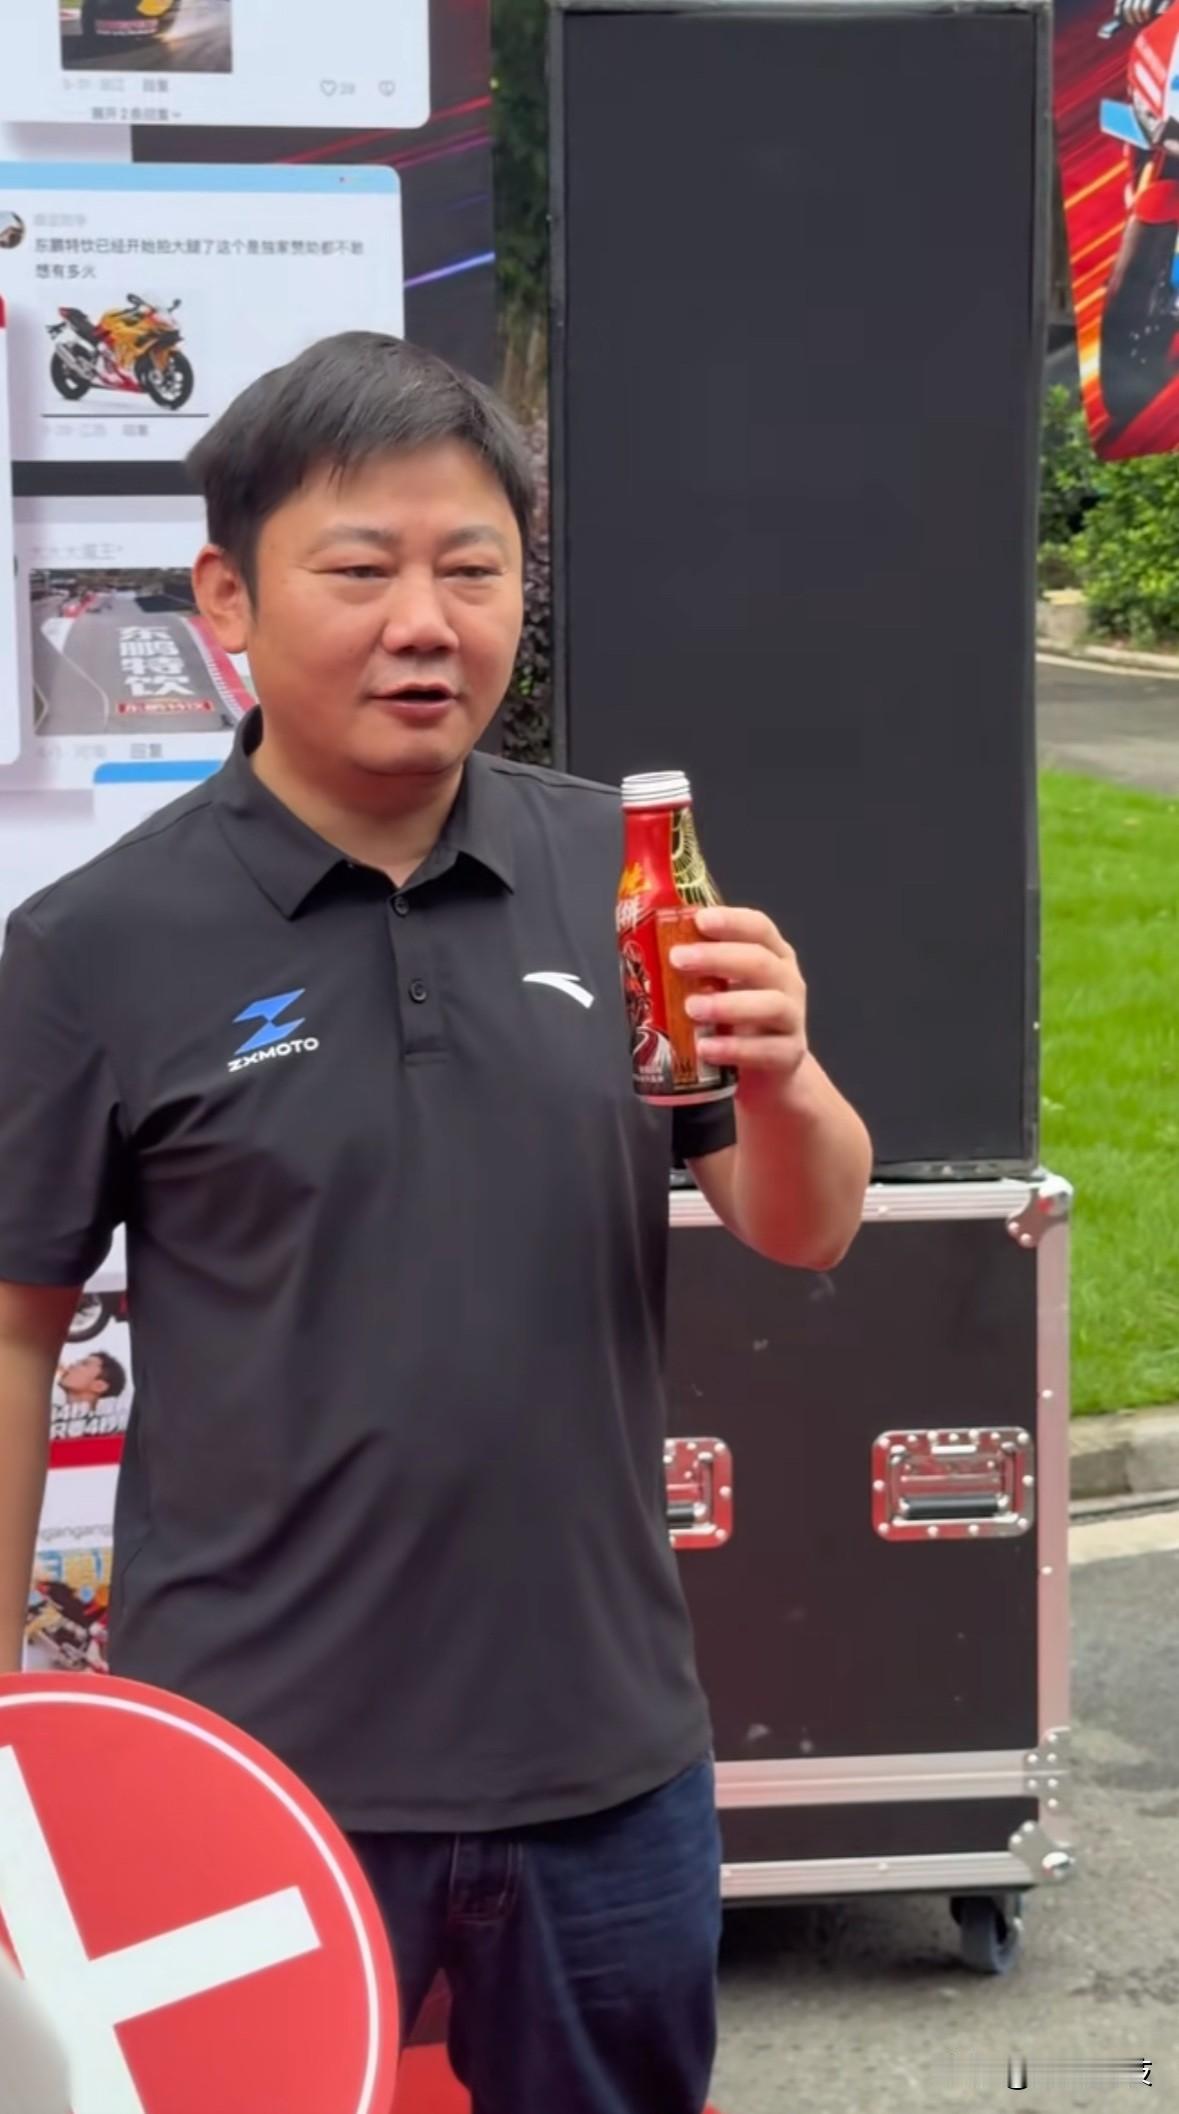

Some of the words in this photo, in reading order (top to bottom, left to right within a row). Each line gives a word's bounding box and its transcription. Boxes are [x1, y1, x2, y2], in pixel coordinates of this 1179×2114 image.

[118, 626, 196, 696] 东鹏特饮
[227, 1036, 319, 1073] ZXMOTO
